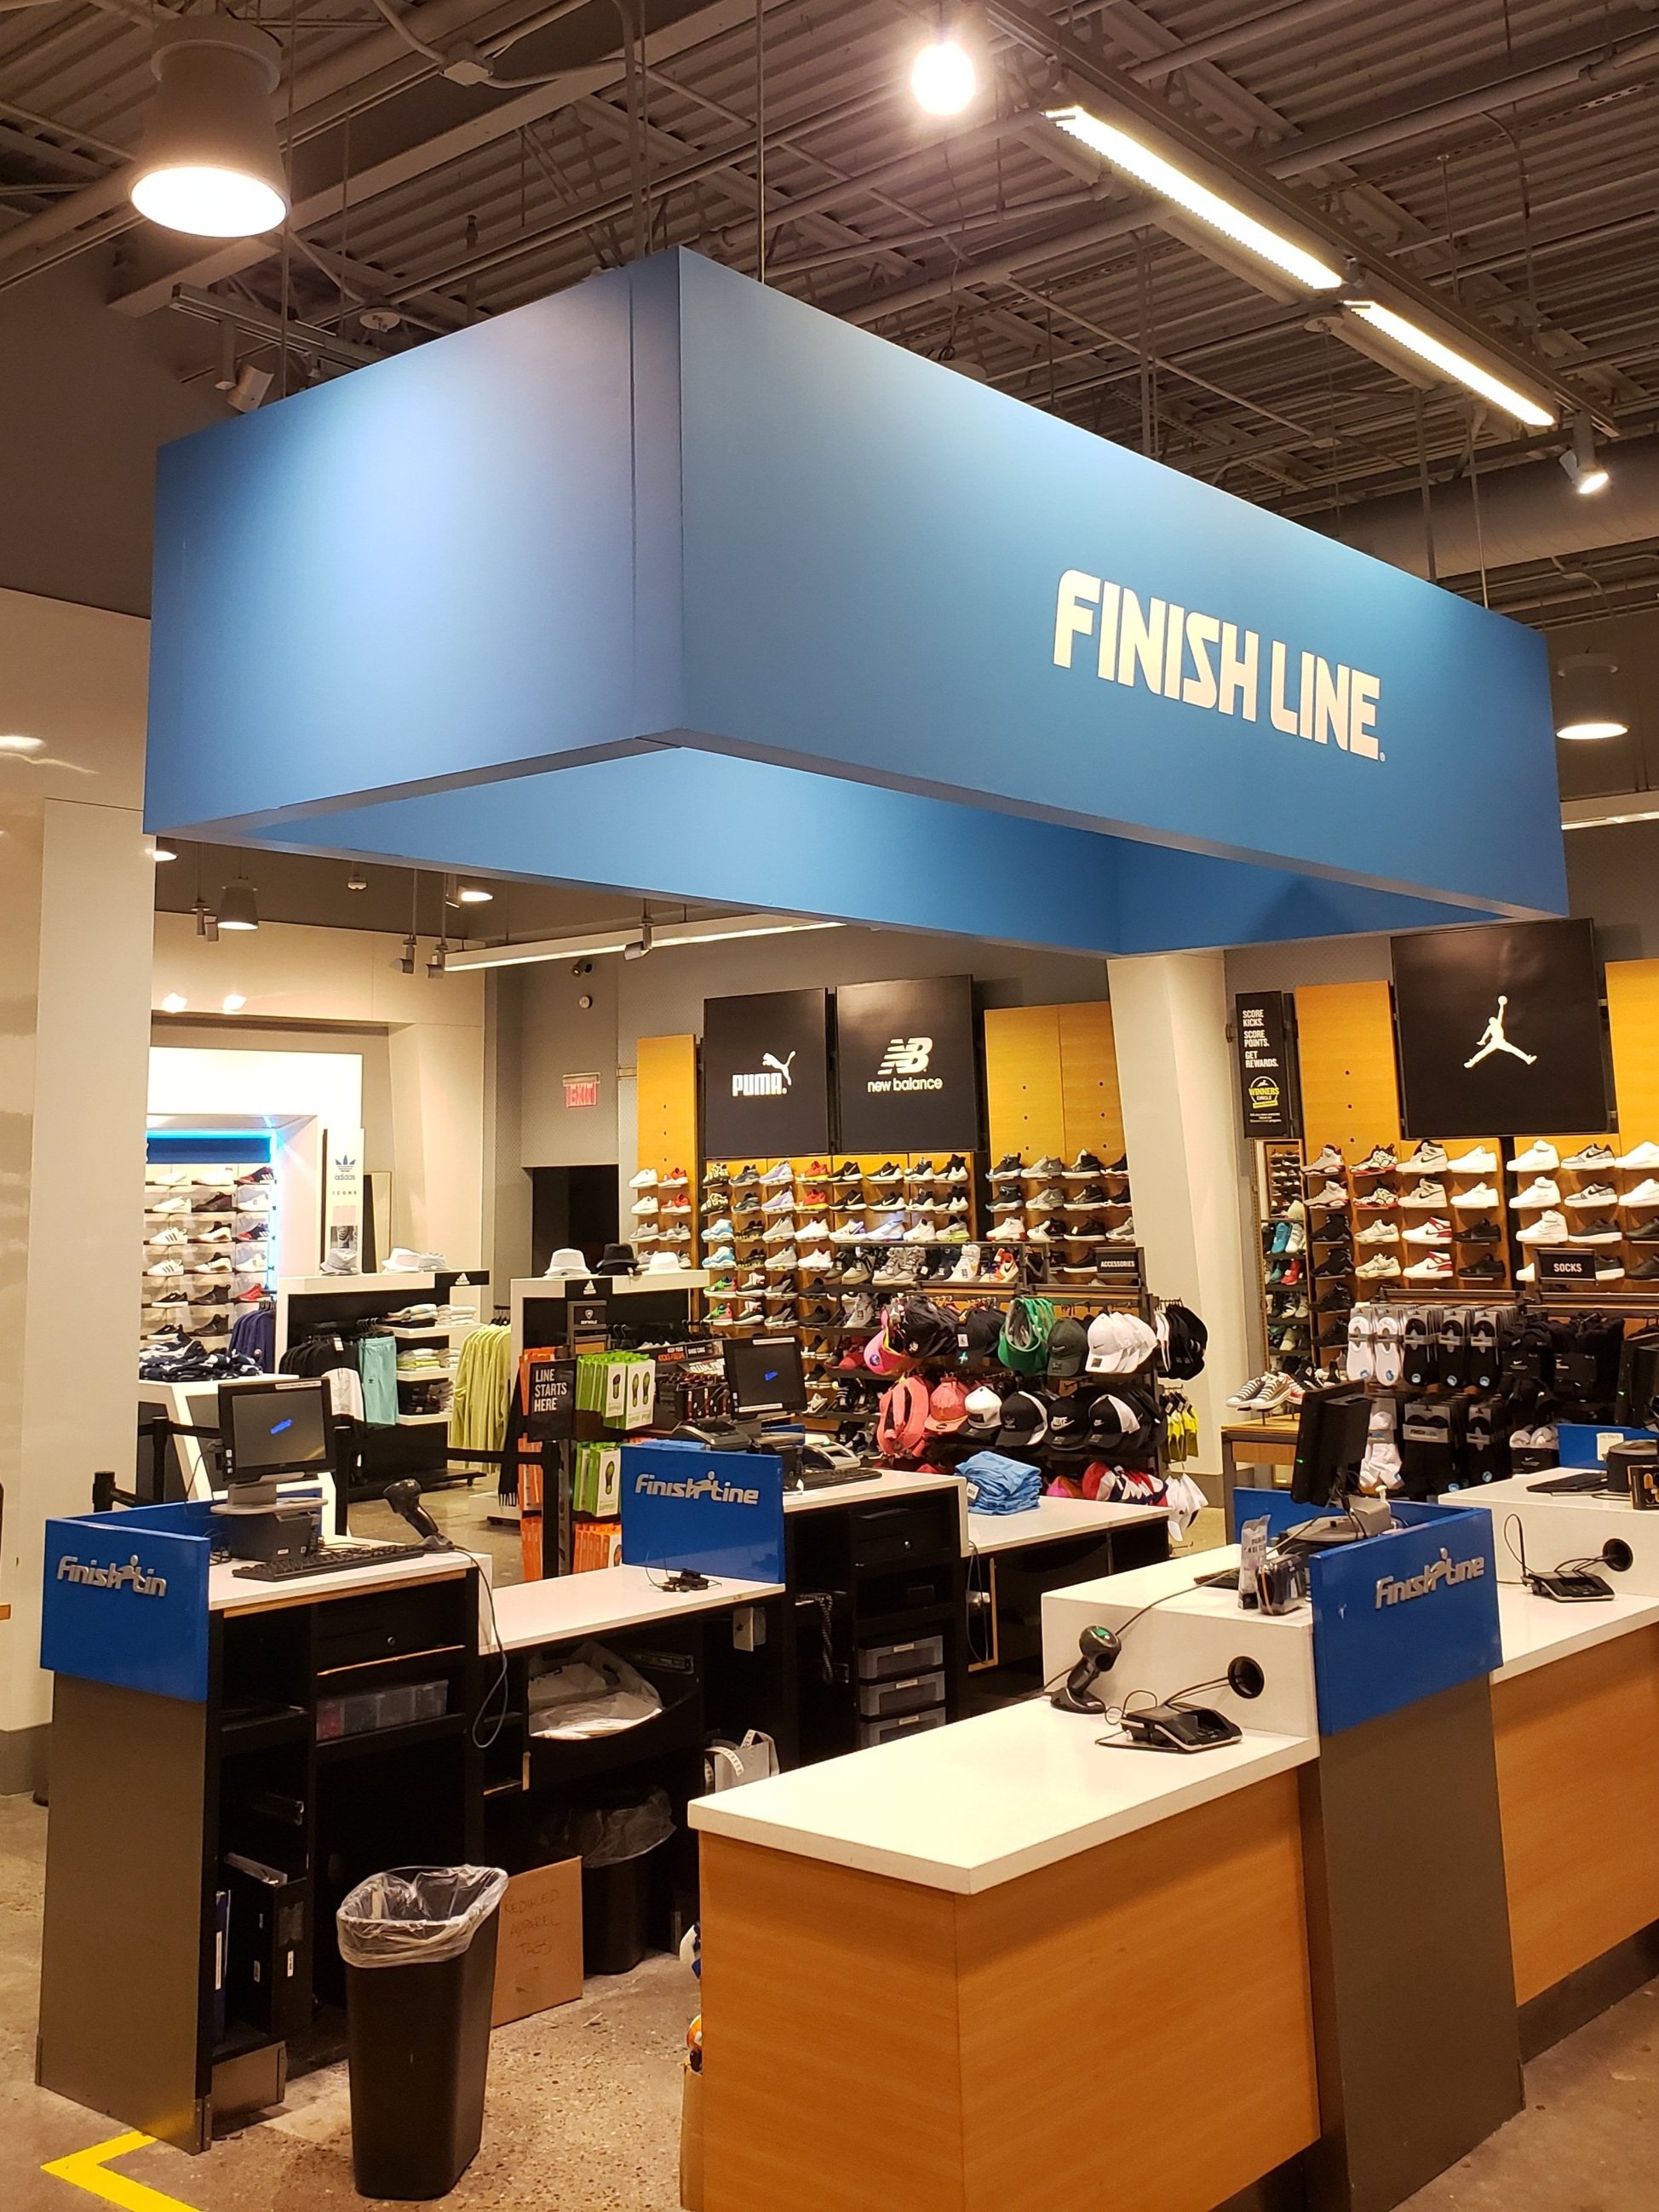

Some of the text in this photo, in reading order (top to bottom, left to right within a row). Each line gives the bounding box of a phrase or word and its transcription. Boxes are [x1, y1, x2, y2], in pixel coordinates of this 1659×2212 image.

[1053, 569, 1381, 761] FINISH LINE
[1243, 1009, 1264, 1019] SCORE
[1243, 1019, 1265, 1027] KICKS.
[1243, 1030, 1266, 1038] SCORE
[1244, 1038, 1270, 1048] POINTS.
[1245, 1050, 1258, 1060] GET
[1245, 1059, 1279, 1068] REWARDS.
[732, 1072, 783, 1096] PUMA
[867, 1077, 943, 1093] new balance
[569, 1083, 596, 1106] EXIT
[1249, 1087, 1279, 1096] WINNERS
[1553, 1263, 1582, 1273] SOCKS
[535, 1369, 555, 1382] LINE
[535, 1382, 567, 1398] STARTS
[534, 1398, 558, 1412] HERE
